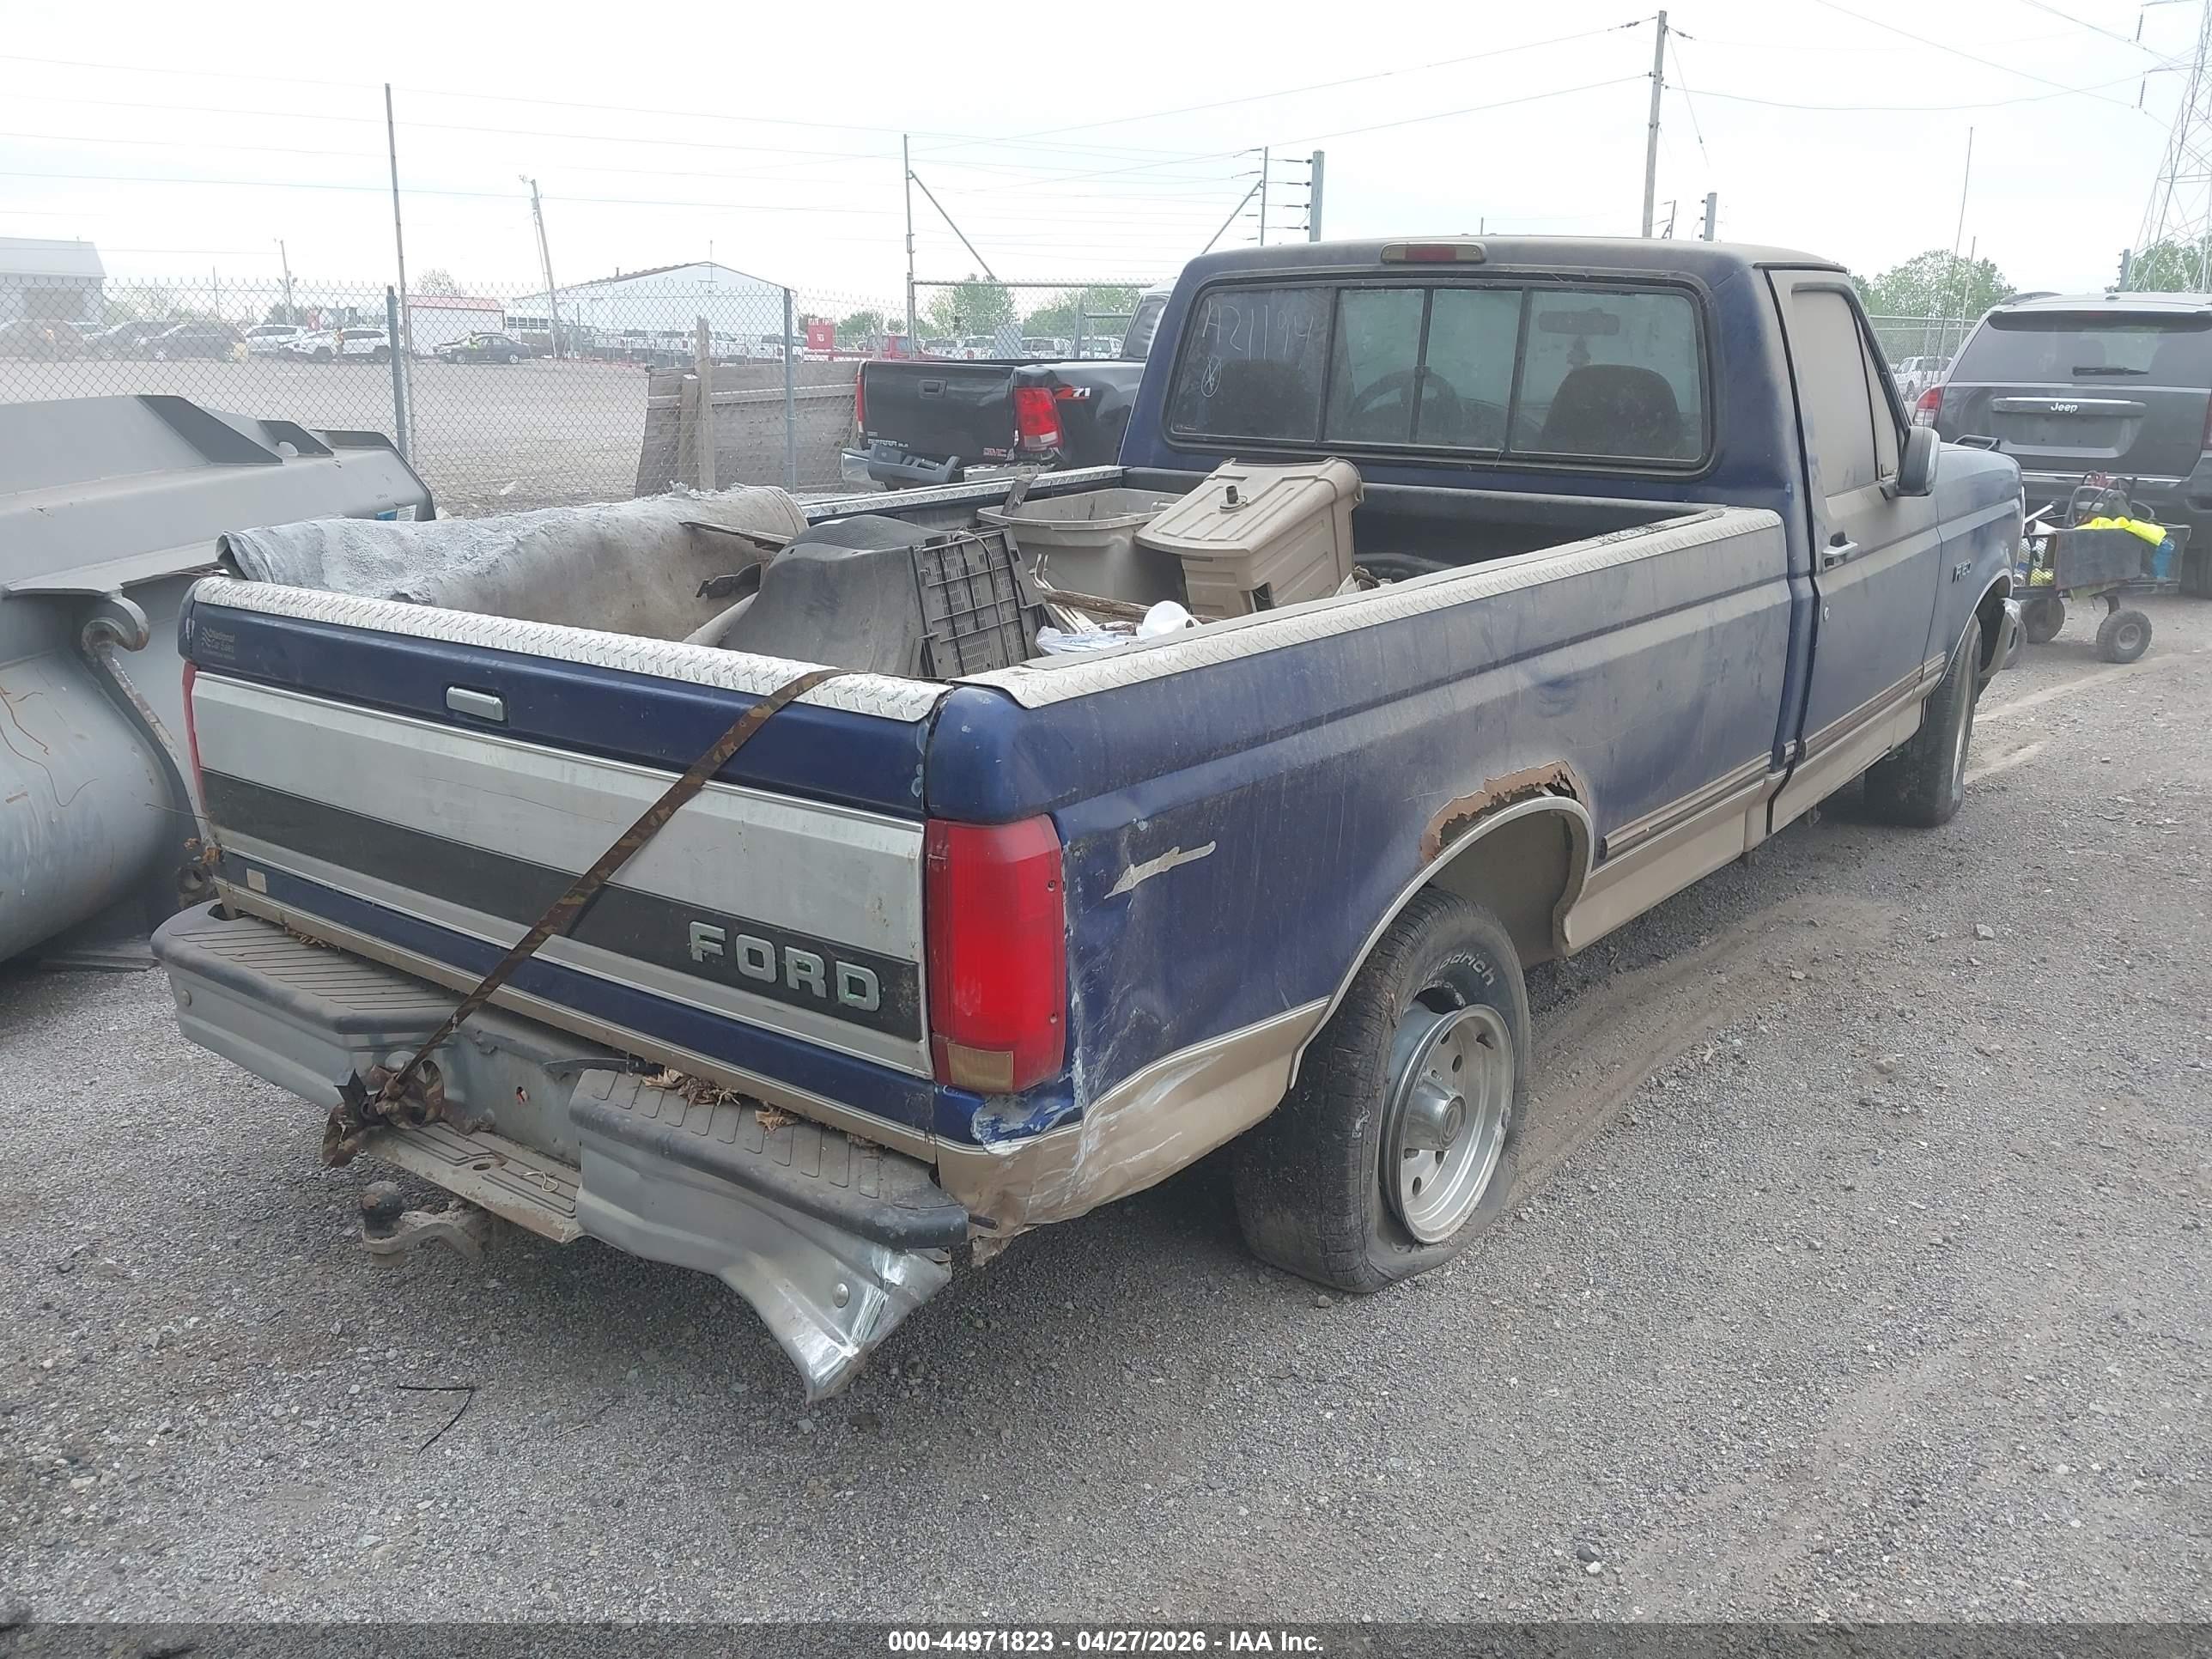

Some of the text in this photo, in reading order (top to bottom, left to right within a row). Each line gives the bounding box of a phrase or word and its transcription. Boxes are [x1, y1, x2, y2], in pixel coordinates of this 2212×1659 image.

[1201, 299, 1315, 362] A21194
[2050, 402, 2079, 414] Jeep
[982, 447, 1007, 458] GMC
[688, 921, 881, 1012] FORD
